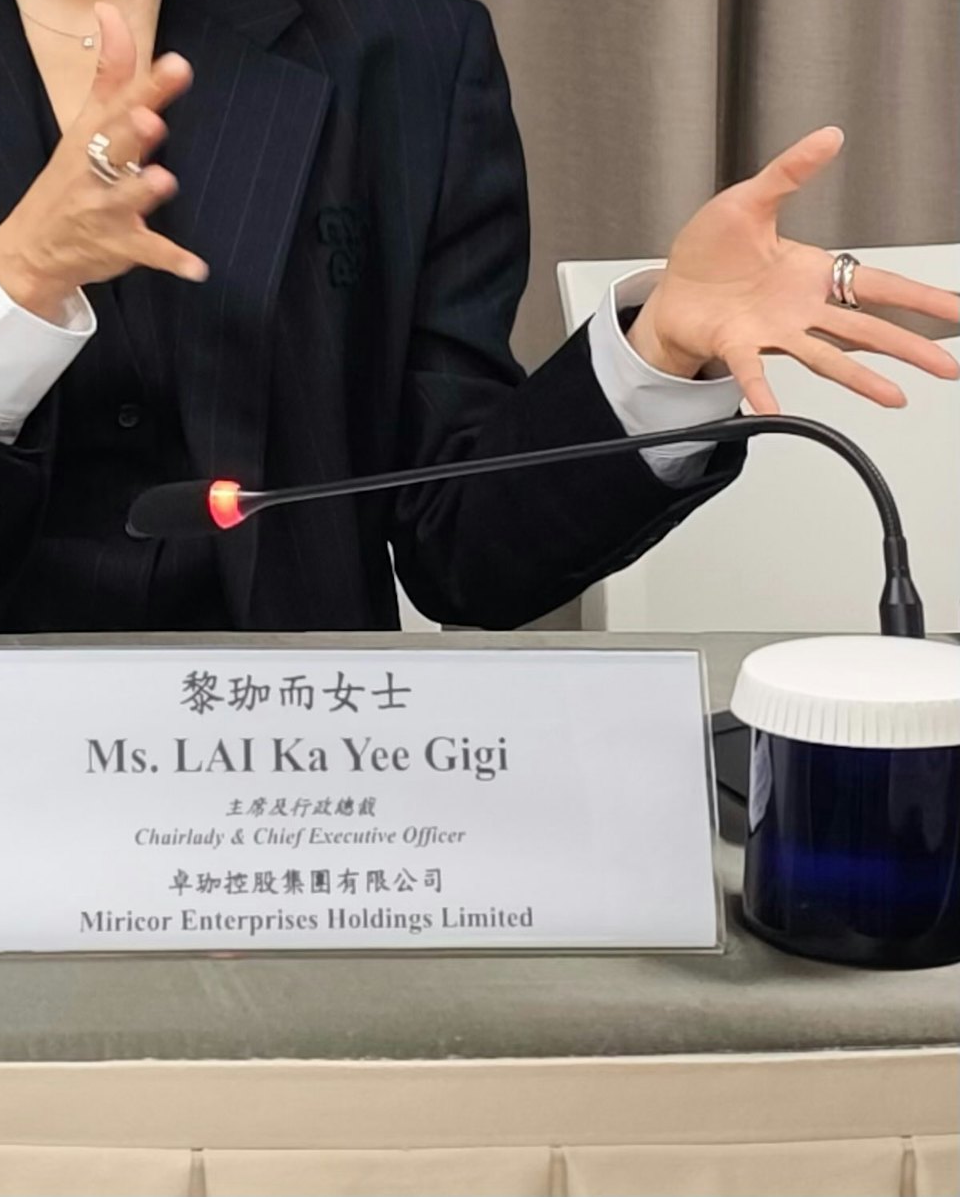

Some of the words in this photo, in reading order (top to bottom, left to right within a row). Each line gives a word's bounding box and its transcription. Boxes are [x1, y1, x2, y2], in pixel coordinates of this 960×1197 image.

[179, 670, 413, 715] 黎珈而女士
[86, 737, 159, 774] Ms.
[173, 737, 255, 773] LAI
[271, 737, 329, 773] Ka
[341, 736, 411, 773] Yee
[424, 735, 509, 781] Gigi
[226, 796, 377, 818] 主席及行政總裁
[134, 827, 225, 849] Chairlady
[230, 828, 245, 845] &
[253, 827, 305, 849] Chief
[308, 827, 397, 845] Executive
[402, 826, 467, 848] Officer
[169, 868, 442, 896] 卓珈控股集團有限公司
[80, 909, 174, 934] Miricor
[180, 908, 319, 937] Enterprises
[327, 907, 434, 935] Holdings
[441, 906, 534, 929] Limited
